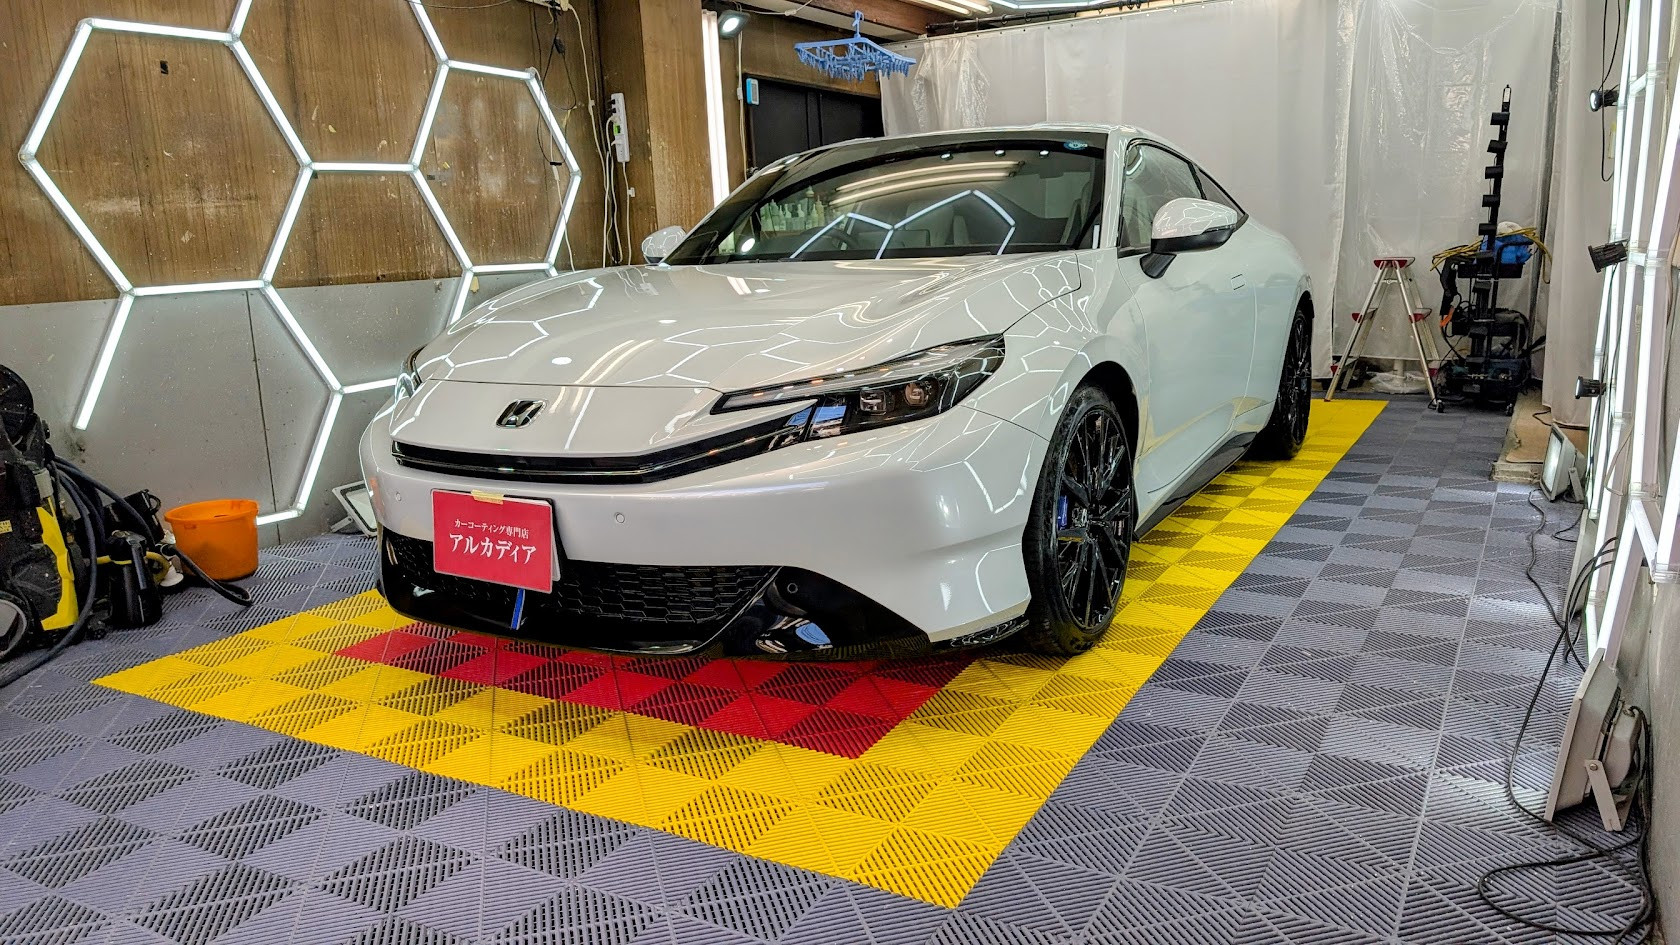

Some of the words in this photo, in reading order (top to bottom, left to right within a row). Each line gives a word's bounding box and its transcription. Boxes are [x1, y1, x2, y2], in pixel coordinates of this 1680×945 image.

[455, 519, 529, 539] カーコーティング専門店
[449, 533, 537, 565] アルカディア
